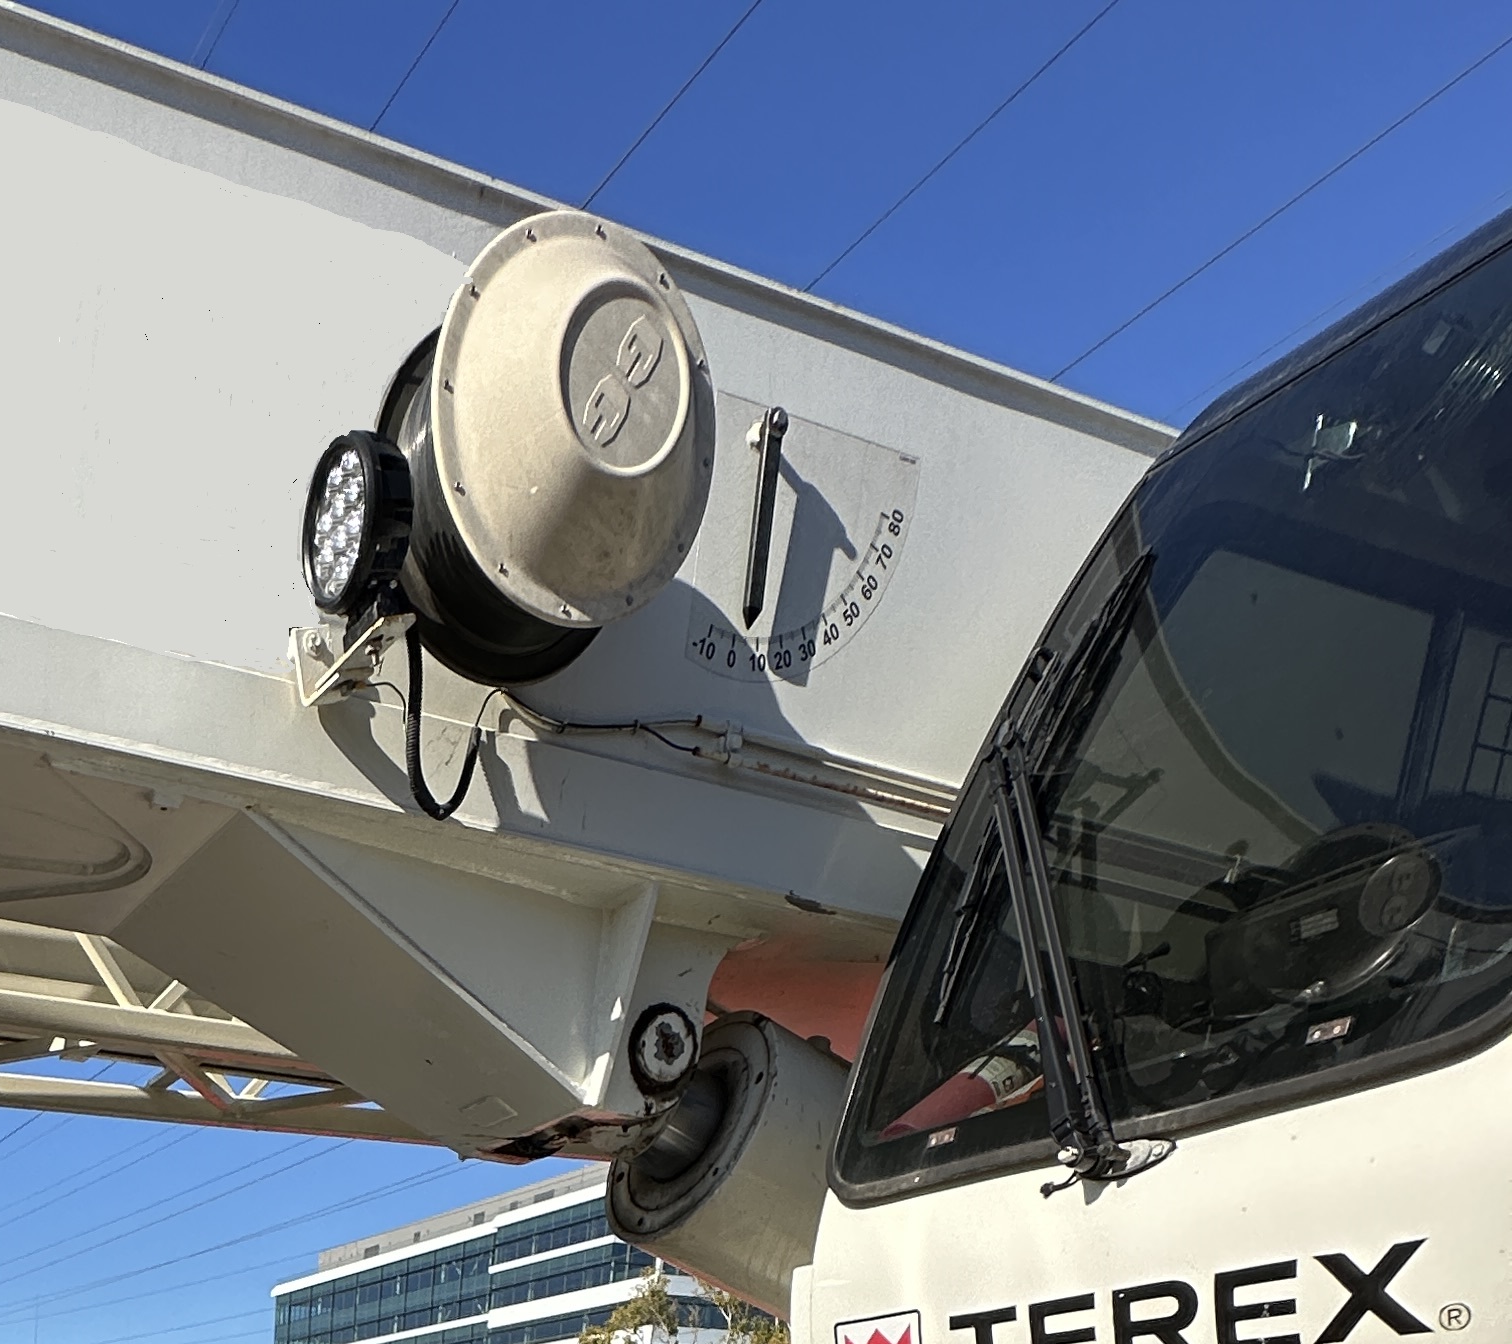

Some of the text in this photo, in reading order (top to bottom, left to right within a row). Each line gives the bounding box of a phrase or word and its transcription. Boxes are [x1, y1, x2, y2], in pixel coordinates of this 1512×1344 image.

[692, 509, 904, 671] -10 0 10 20 30 40 50 60 70 80
